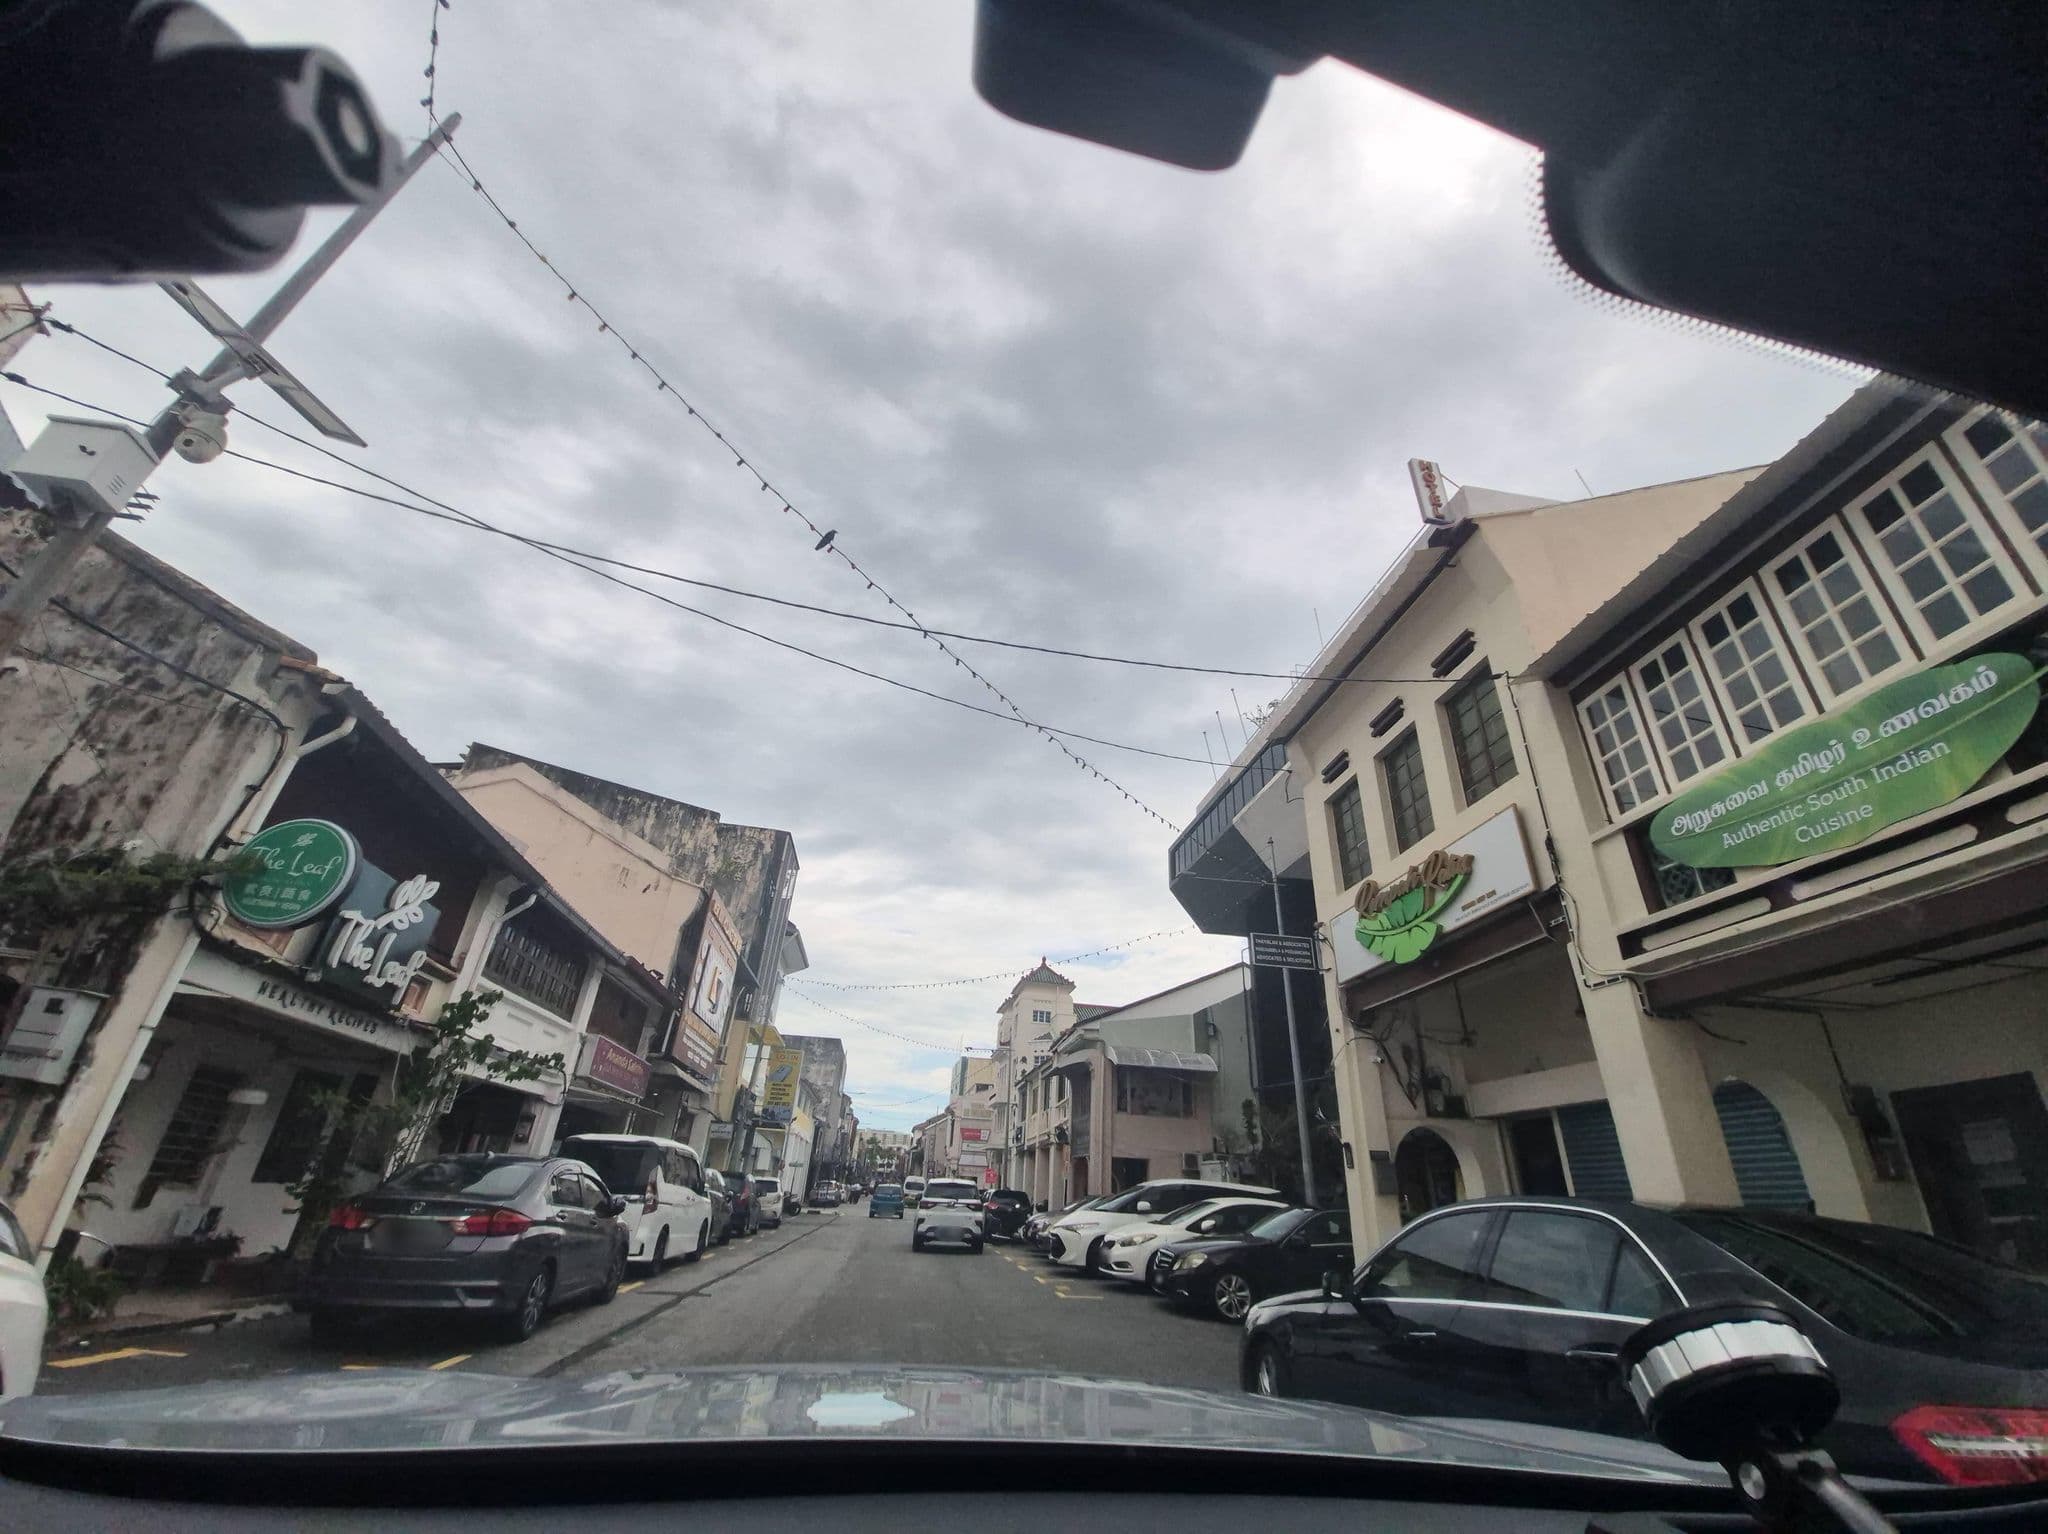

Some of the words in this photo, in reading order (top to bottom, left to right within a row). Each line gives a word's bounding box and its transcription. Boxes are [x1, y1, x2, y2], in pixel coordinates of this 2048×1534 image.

[1418, 460, 1445, 520] HOTEL
[1671, 780, 1769, 836] அறுசுவை
[1775, 738, 1848, 792] தமிழர்
[1851, 664, 2000, 750] உணவகம்
[1721, 798, 1806, 850] Authentic
[1806, 775, 1870, 811] South
[1869, 738, 1952, 785] Indian
[1794, 801, 1875, 844] Cuisine
[287, 850, 343, 881] Leaf
[326, 909, 376, 971] The
[363, 932, 427, 1006] Leaf
[1256, 954, 1283, 962] ADVOCATES
[258, 980, 326, 1015] HEALTHY
[328, 1008, 378, 1034] RECIPES
